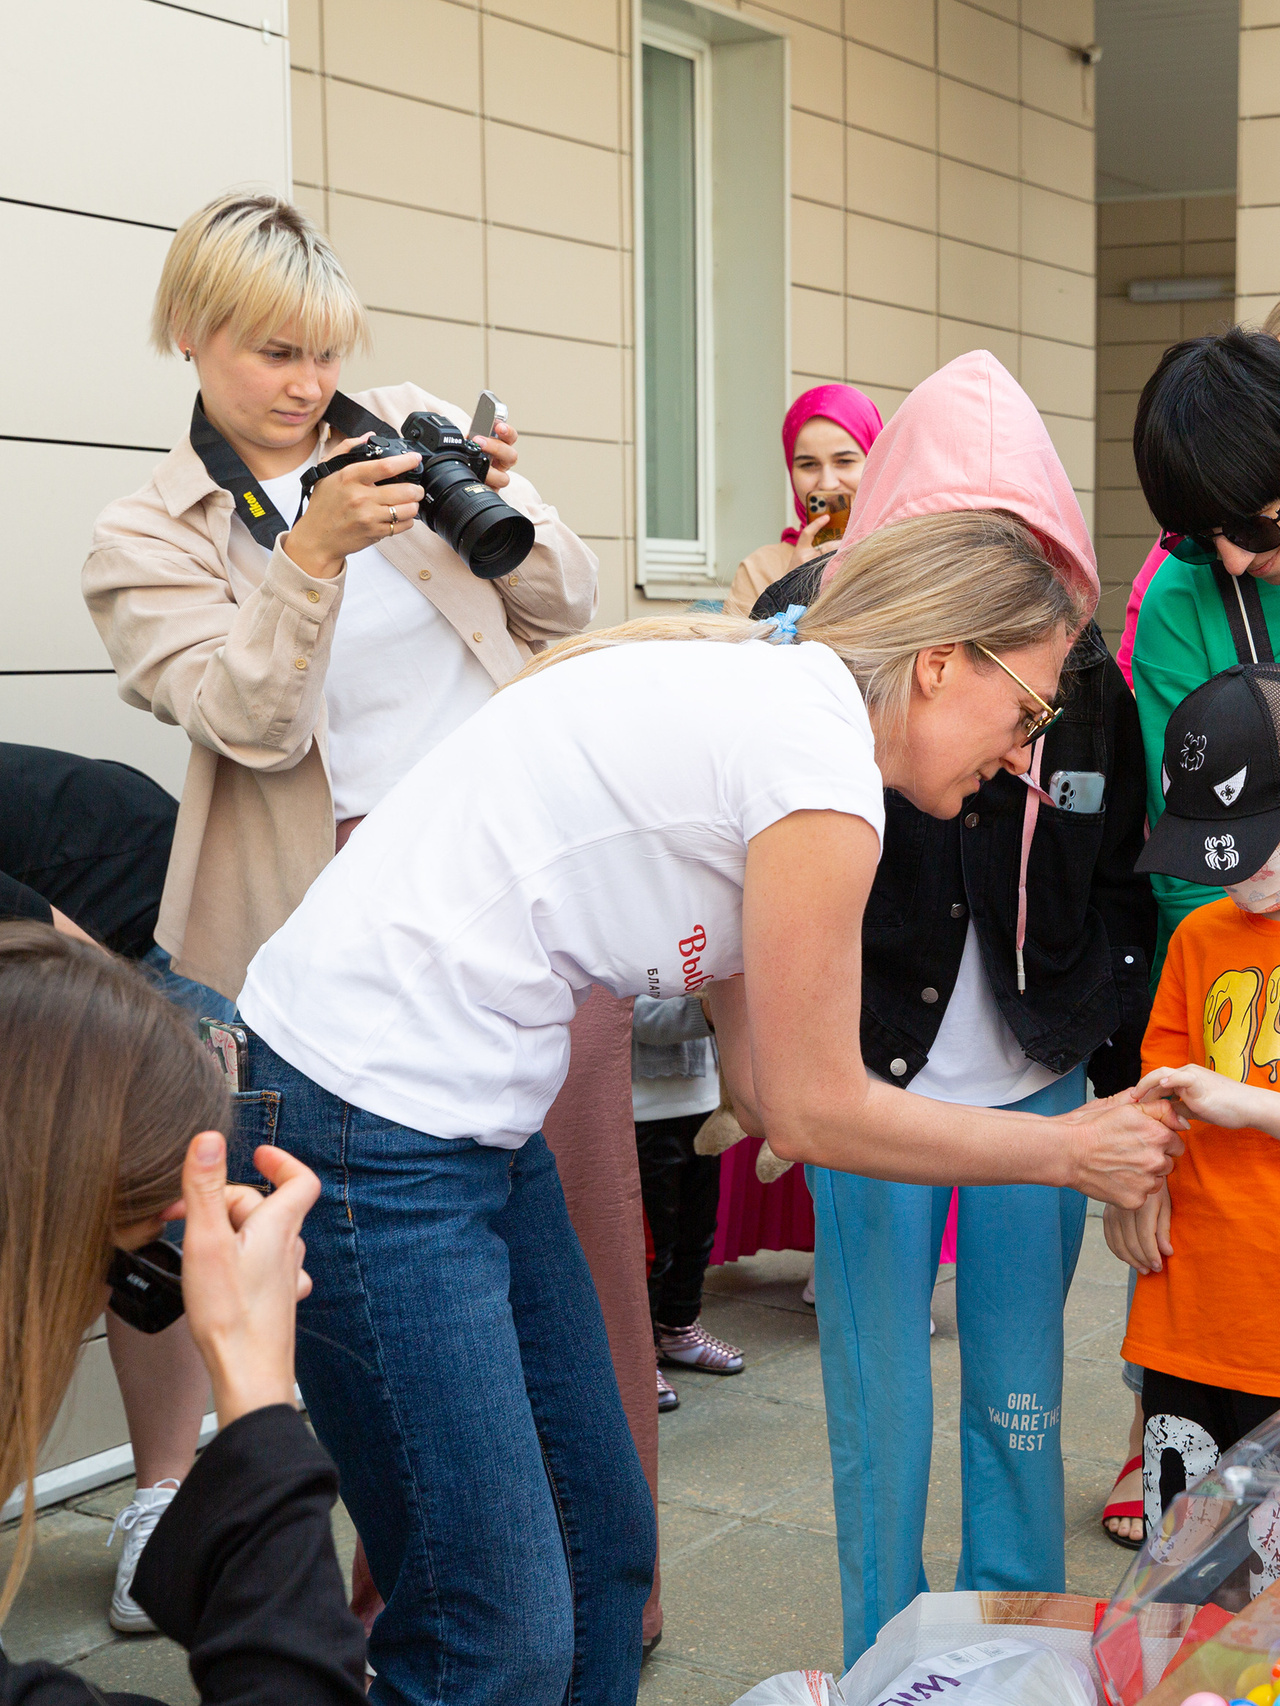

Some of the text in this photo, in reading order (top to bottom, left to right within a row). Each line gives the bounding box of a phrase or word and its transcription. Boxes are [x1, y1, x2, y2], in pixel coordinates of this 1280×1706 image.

[443, 436, 463, 445] Nikon
[243, 491, 266, 518] Nikon
[1007, 1392, 1043, 1411] GIRL,
[1010, 1413, 1040, 1431] ARE
[1042, 1405, 1060, 1430] THE
[1009, 1433, 1045, 1451] BEST
